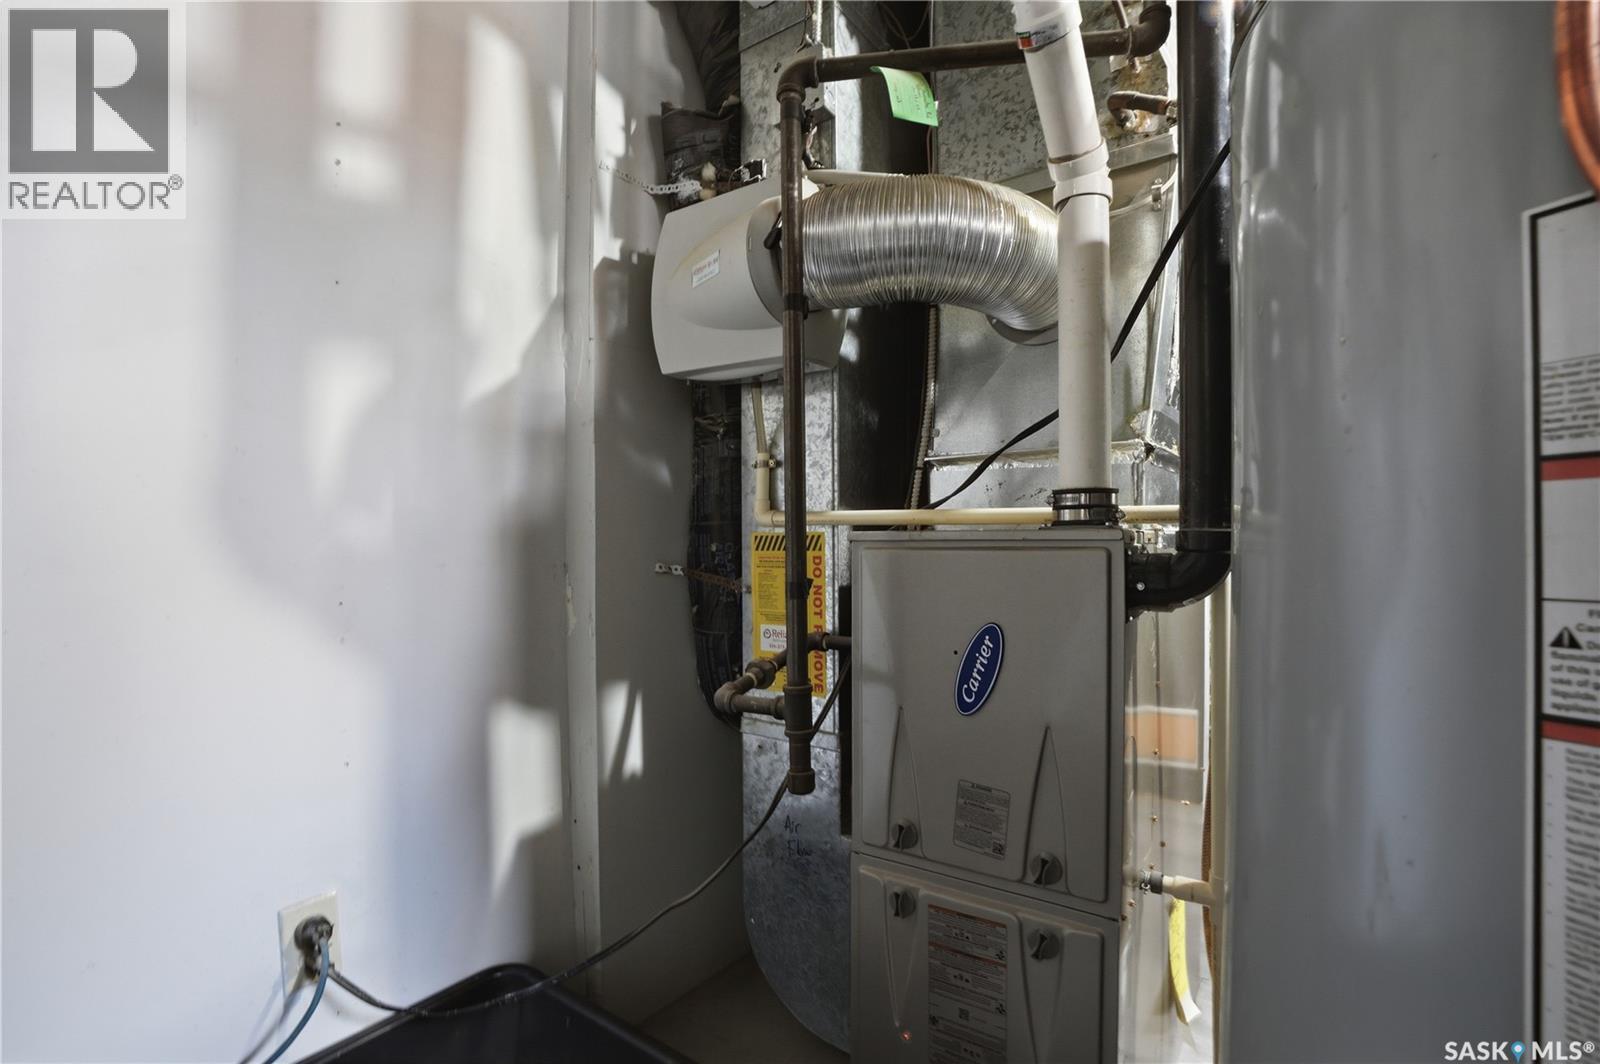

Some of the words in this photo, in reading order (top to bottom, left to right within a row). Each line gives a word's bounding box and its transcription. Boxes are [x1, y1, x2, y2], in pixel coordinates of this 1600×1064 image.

[812, 555, 823, 579] DO
[813, 586, 824, 620] NOT
[813, 624, 825, 693] RMOVE
[962, 634, 994, 703] Carrier
[784, 815, 801, 834] Air
